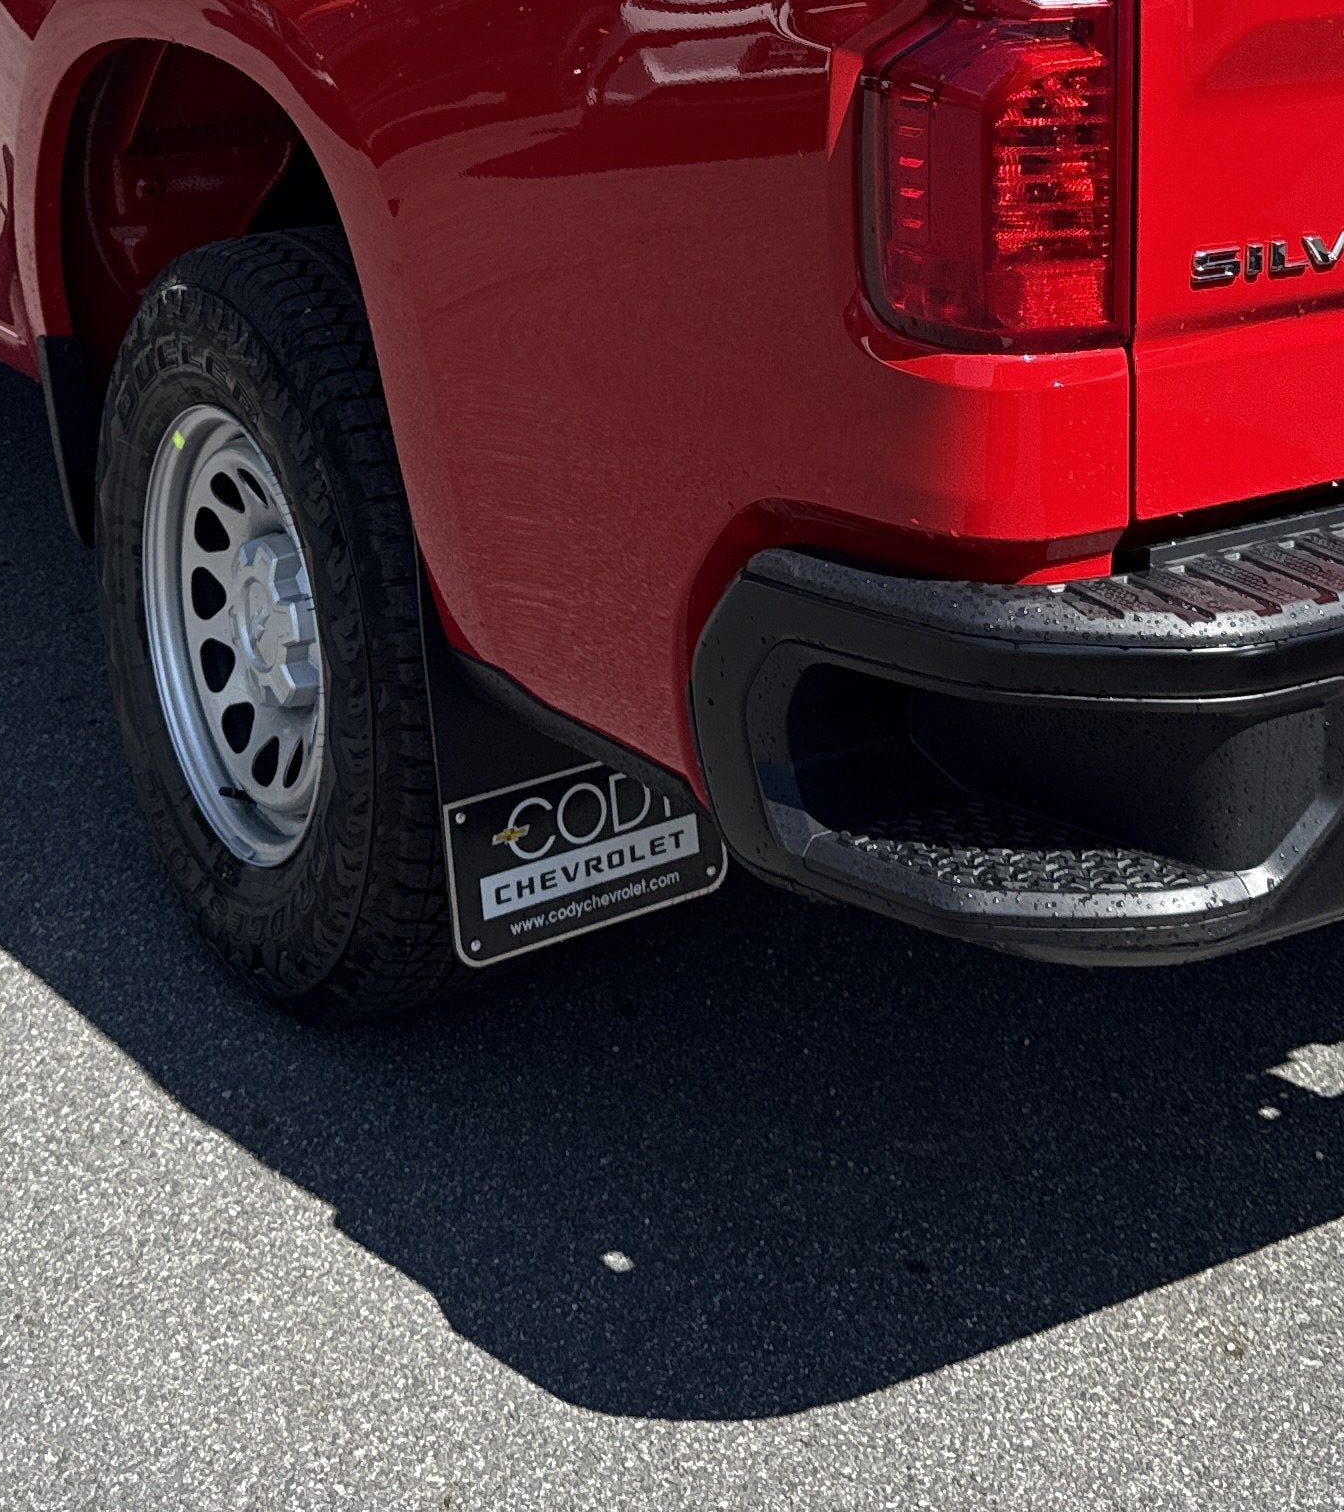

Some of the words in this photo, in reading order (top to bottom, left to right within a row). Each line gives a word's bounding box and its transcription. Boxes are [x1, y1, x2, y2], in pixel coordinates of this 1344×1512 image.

[508, 772, 672, 860] COD
[494, 829, 686, 906] CHEVROLET
[510, 869, 681, 936] www.codychevrolet.com
